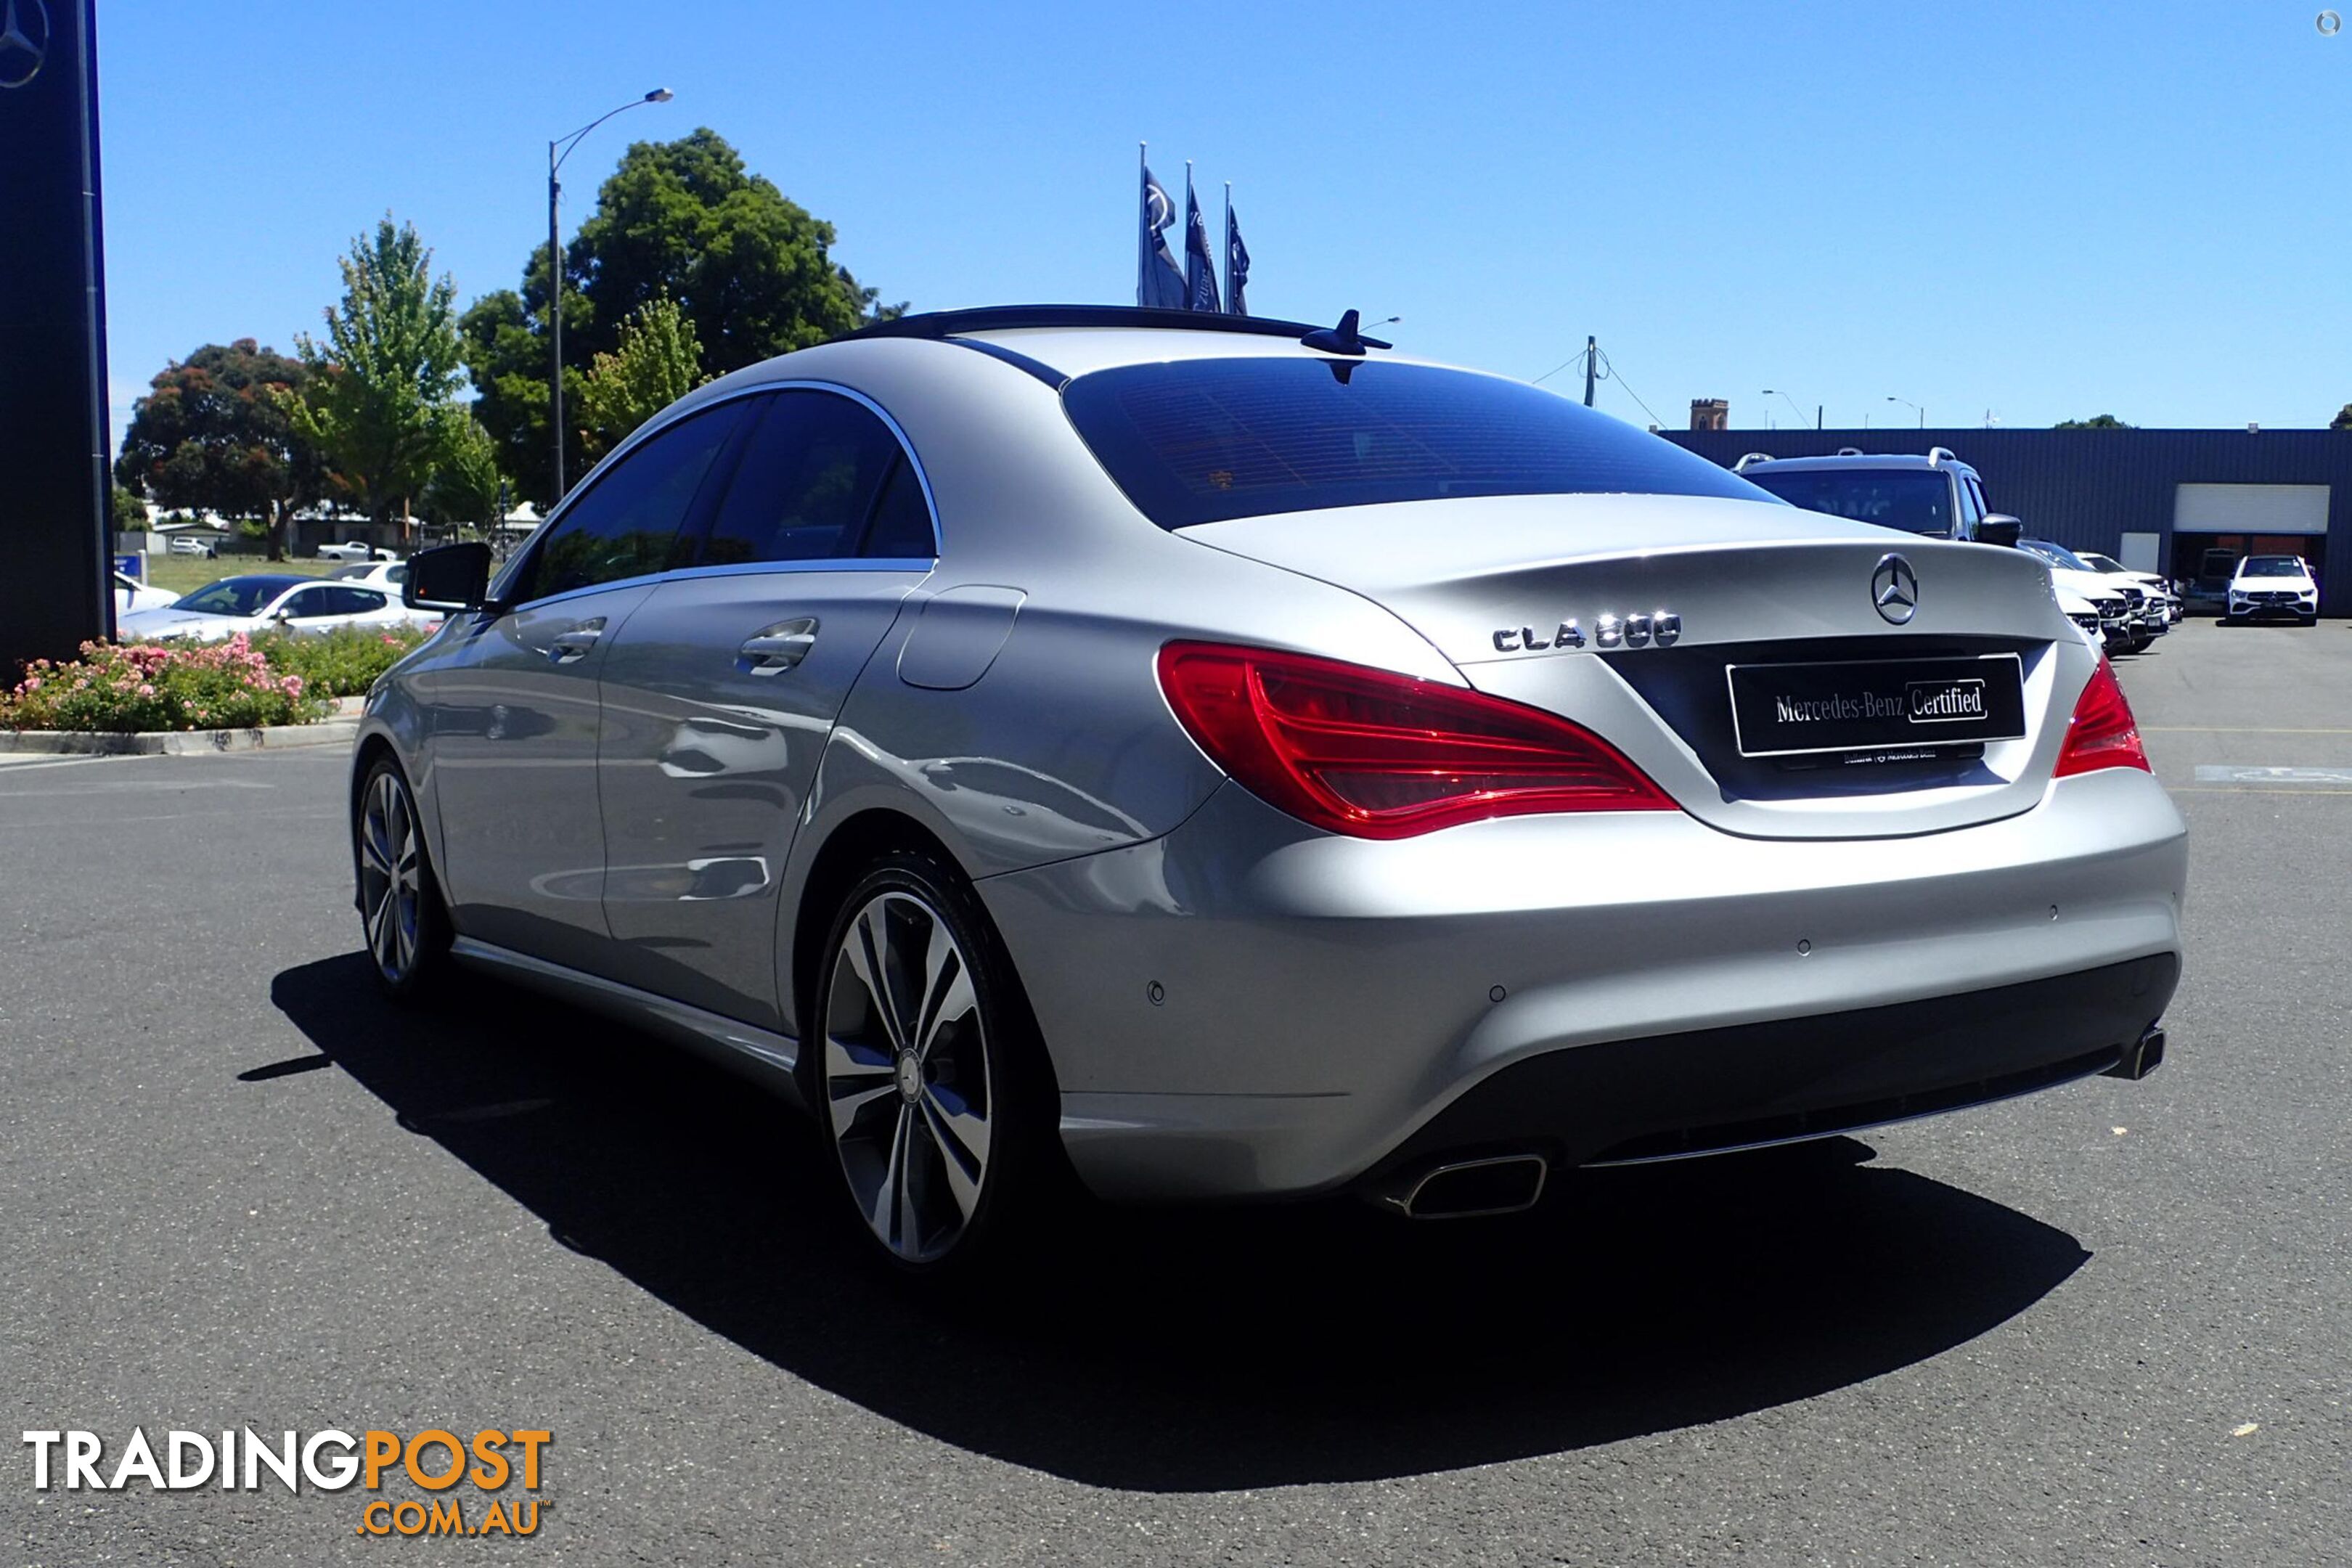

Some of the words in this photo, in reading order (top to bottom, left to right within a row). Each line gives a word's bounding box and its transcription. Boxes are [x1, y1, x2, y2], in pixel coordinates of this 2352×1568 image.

[1493, 618, 1588, 652] CLA
[1777, 691, 1905, 722] Mercedes-Benz
[1912, 686, 1983, 715] Certified
